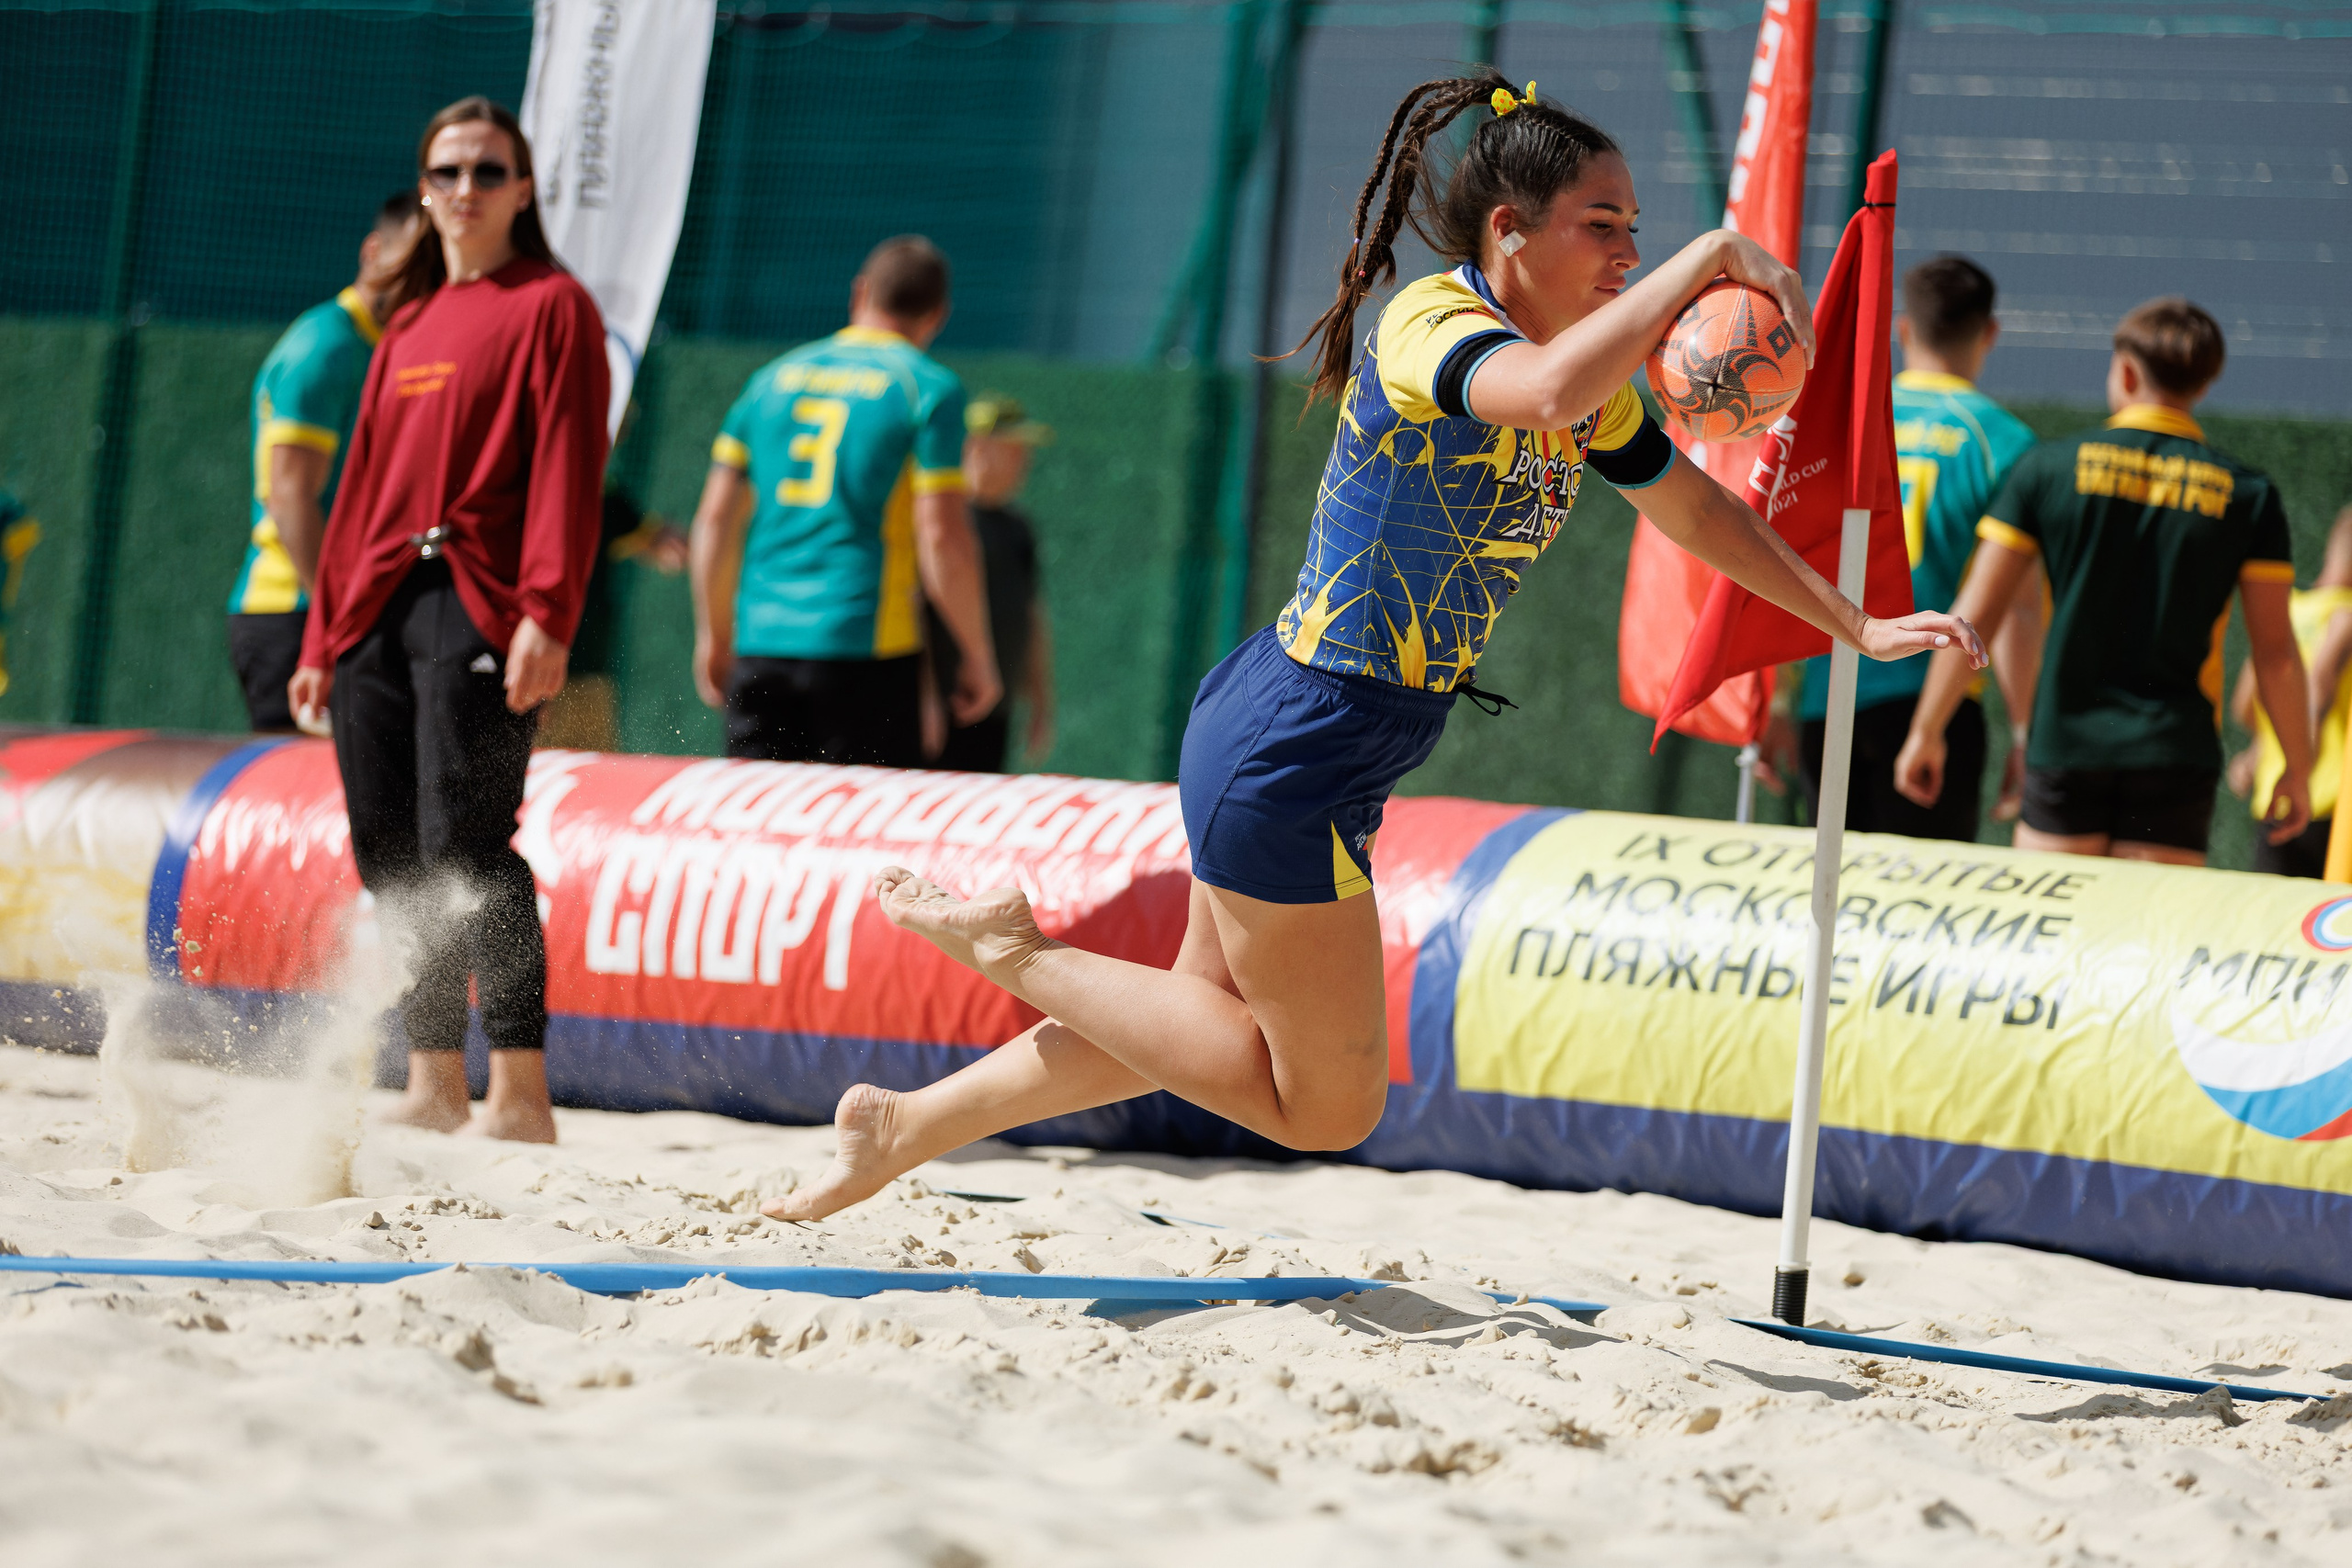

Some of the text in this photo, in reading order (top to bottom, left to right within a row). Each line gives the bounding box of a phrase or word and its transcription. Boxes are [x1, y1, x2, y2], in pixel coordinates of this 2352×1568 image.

[775, 396, 850, 508] 3
[585, 832, 908, 991] СПОРТ
[1875, 959, 2071, 1030] ИГРЫ
